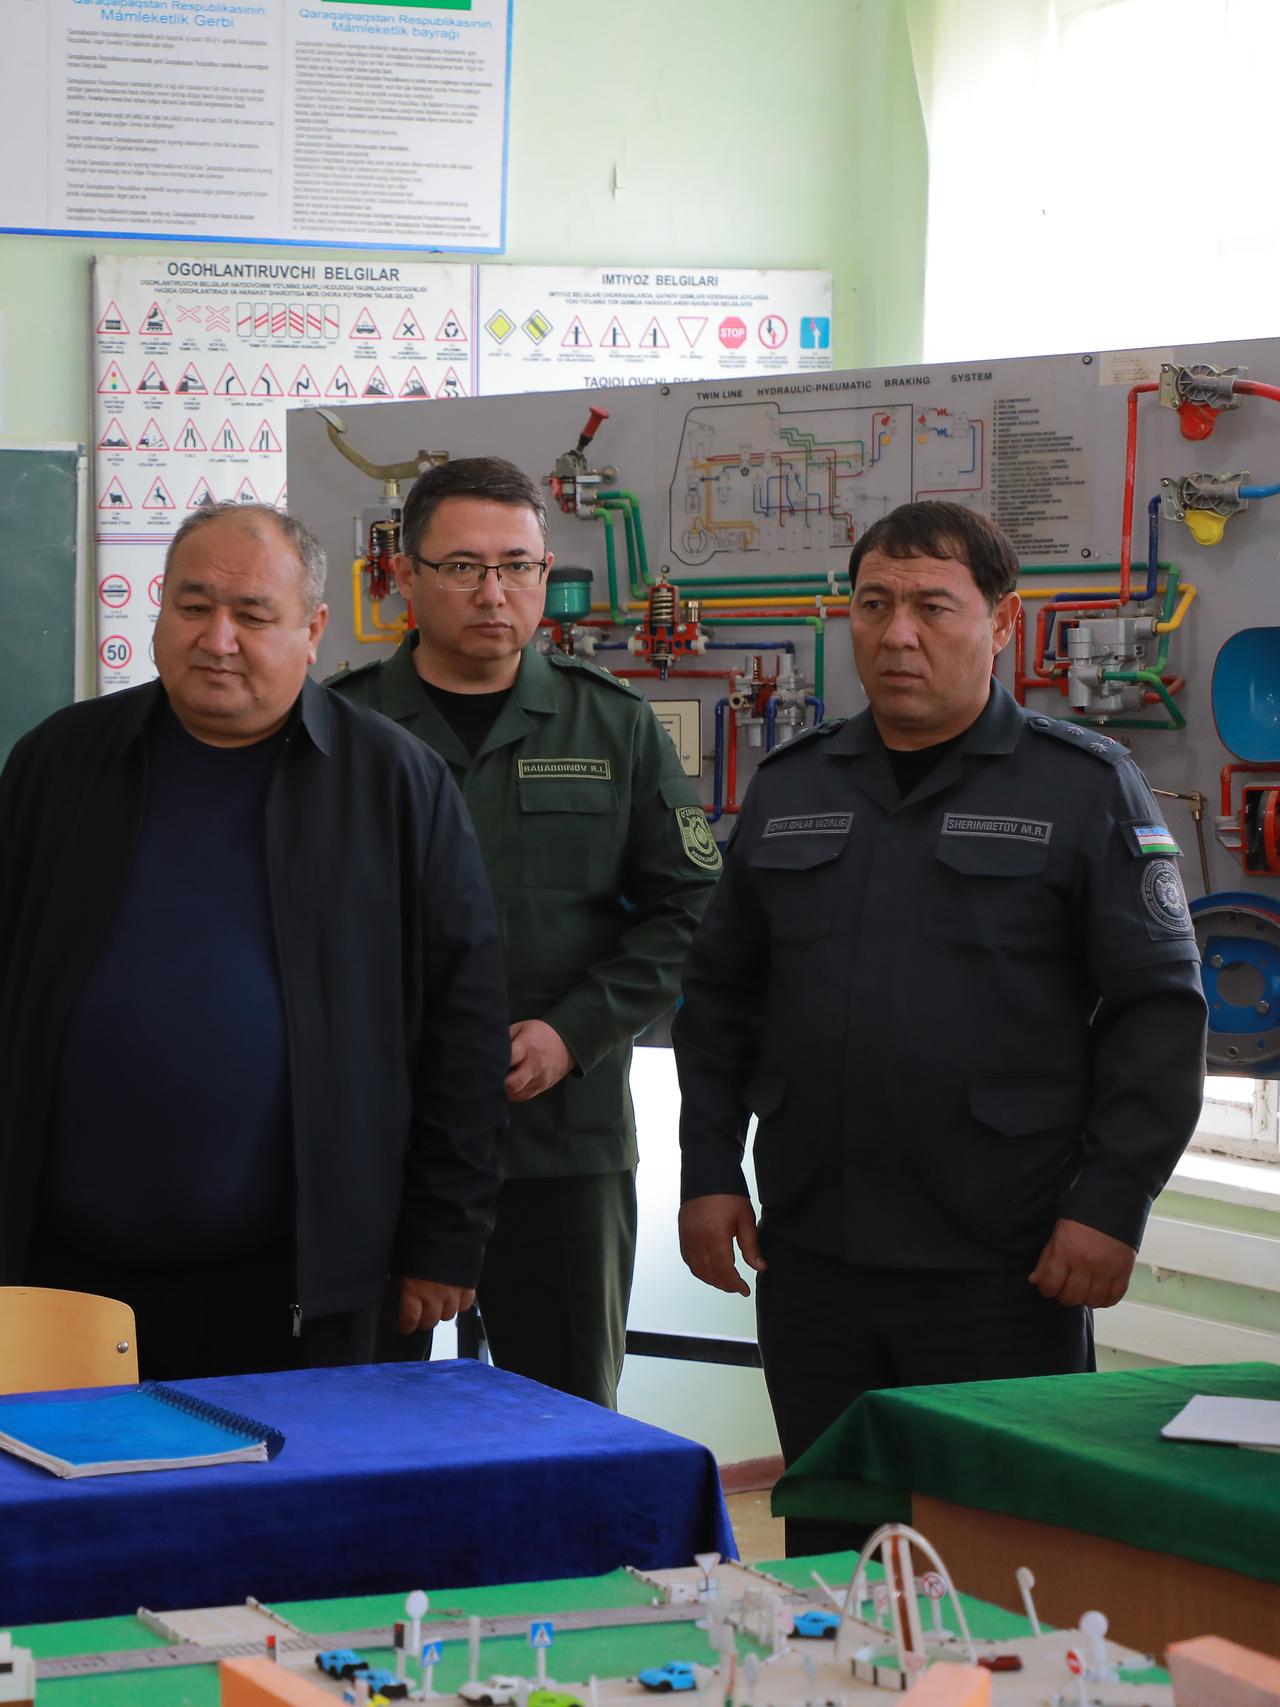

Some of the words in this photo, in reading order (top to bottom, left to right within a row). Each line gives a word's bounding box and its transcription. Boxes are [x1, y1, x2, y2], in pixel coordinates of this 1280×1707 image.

[194, 14, 234, 28] Gerbi
[299, 8, 394, 23] Qaraqalpaqstan
[168, 262, 316, 279] OGOHLANTIRUVCHI
[324, 267, 400, 282] BELGILAR
[602, 274, 650, 286] IMTIYOZ
[656, 275, 719, 287] BELGILARI
[720, 328, 745, 338] STOP
[696, 390, 720, 401] TWIN
[721, 389, 743, 399] LINE
[756, 380, 872, 397] HYDRAULIC-PNEUMATIC
[883, 376, 930, 389] BRAKING
[950, 372, 993, 384] SYSTEM
[107, 644, 127, 661] 50
[948, 819, 1018, 833] SHERIMBETOV
[1021, 825, 1044, 837] M.R.
